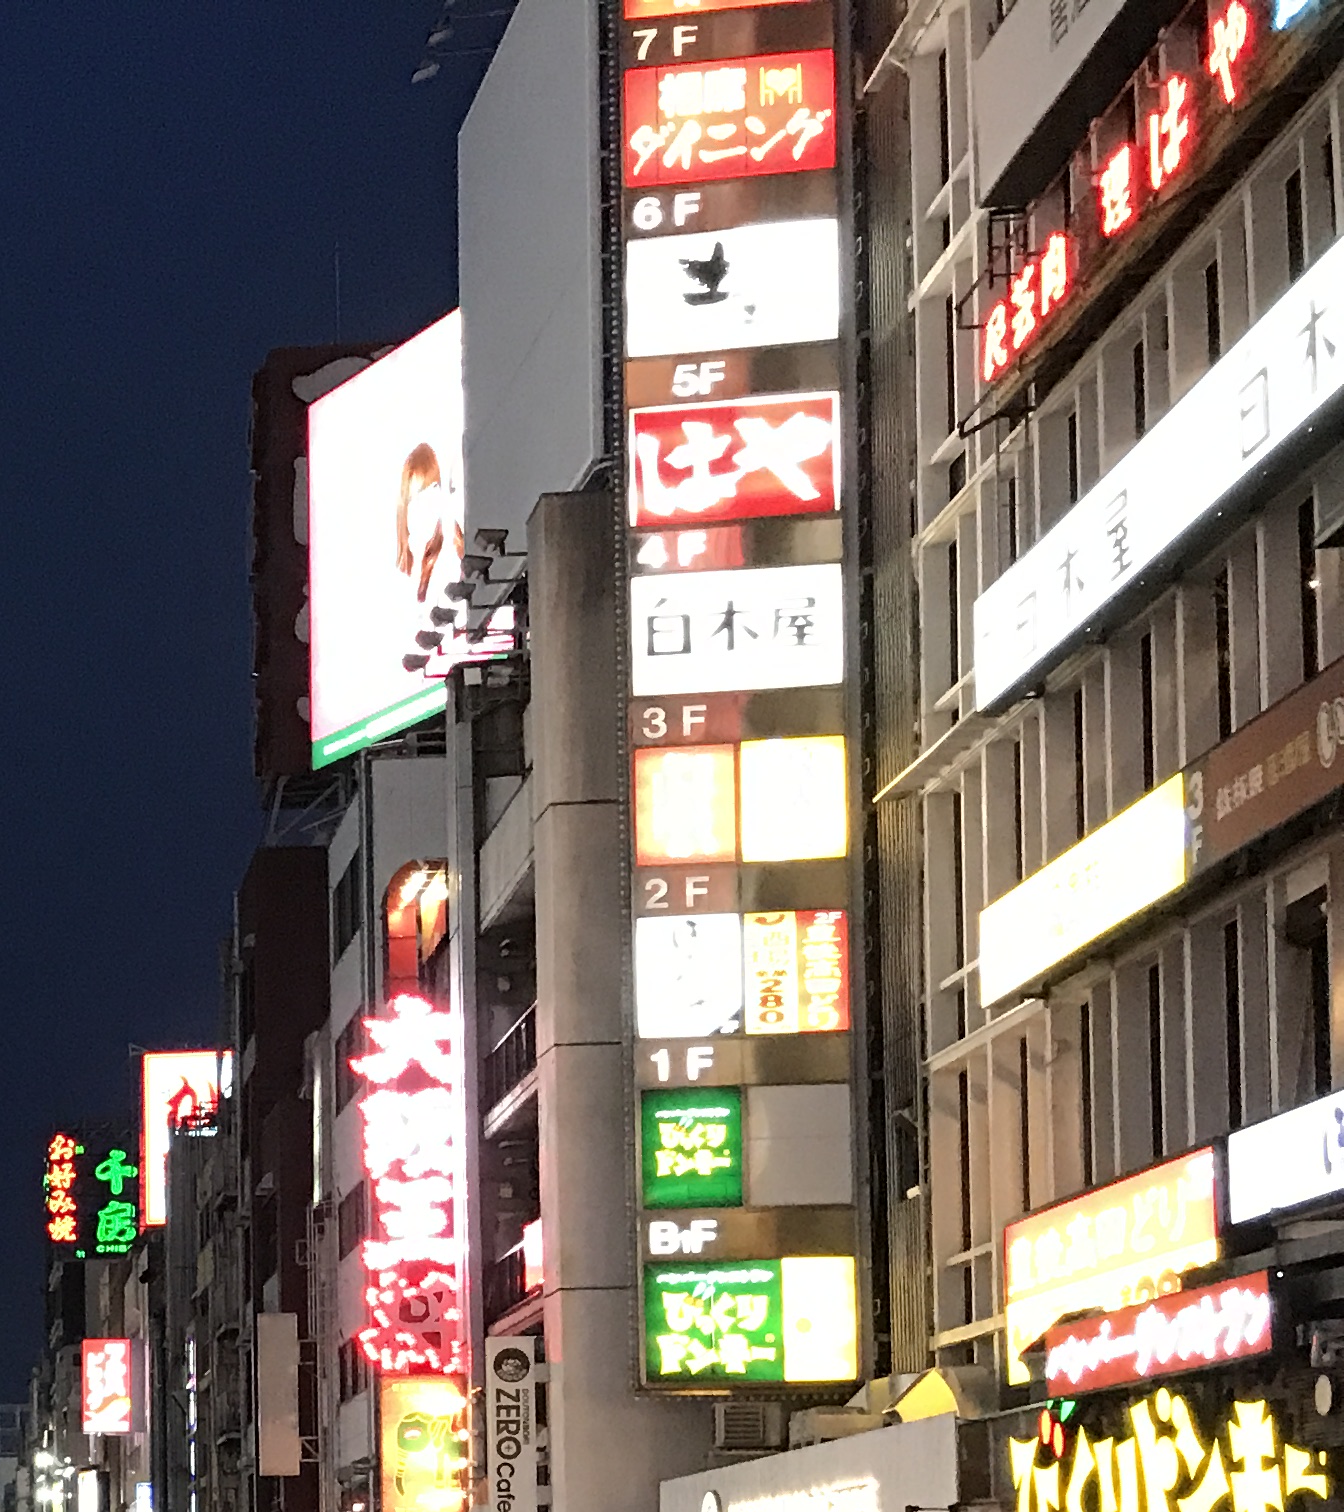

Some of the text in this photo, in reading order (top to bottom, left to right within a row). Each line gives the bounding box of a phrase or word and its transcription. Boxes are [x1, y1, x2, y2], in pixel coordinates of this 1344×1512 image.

[629, 108, 832, 175] ダイニング
[671, 361, 726, 397] 5F
[646, 596, 817, 657] 白木屋
[655, 1149, 731, 1177] ドンキー
[95, 1243, 133, 1253] CHIB
[662, 1289, 769, 1336] びっくり
[656, 1332, 777, 1376] ドンキー
[495, 1388, 522, 1460] ZERO
